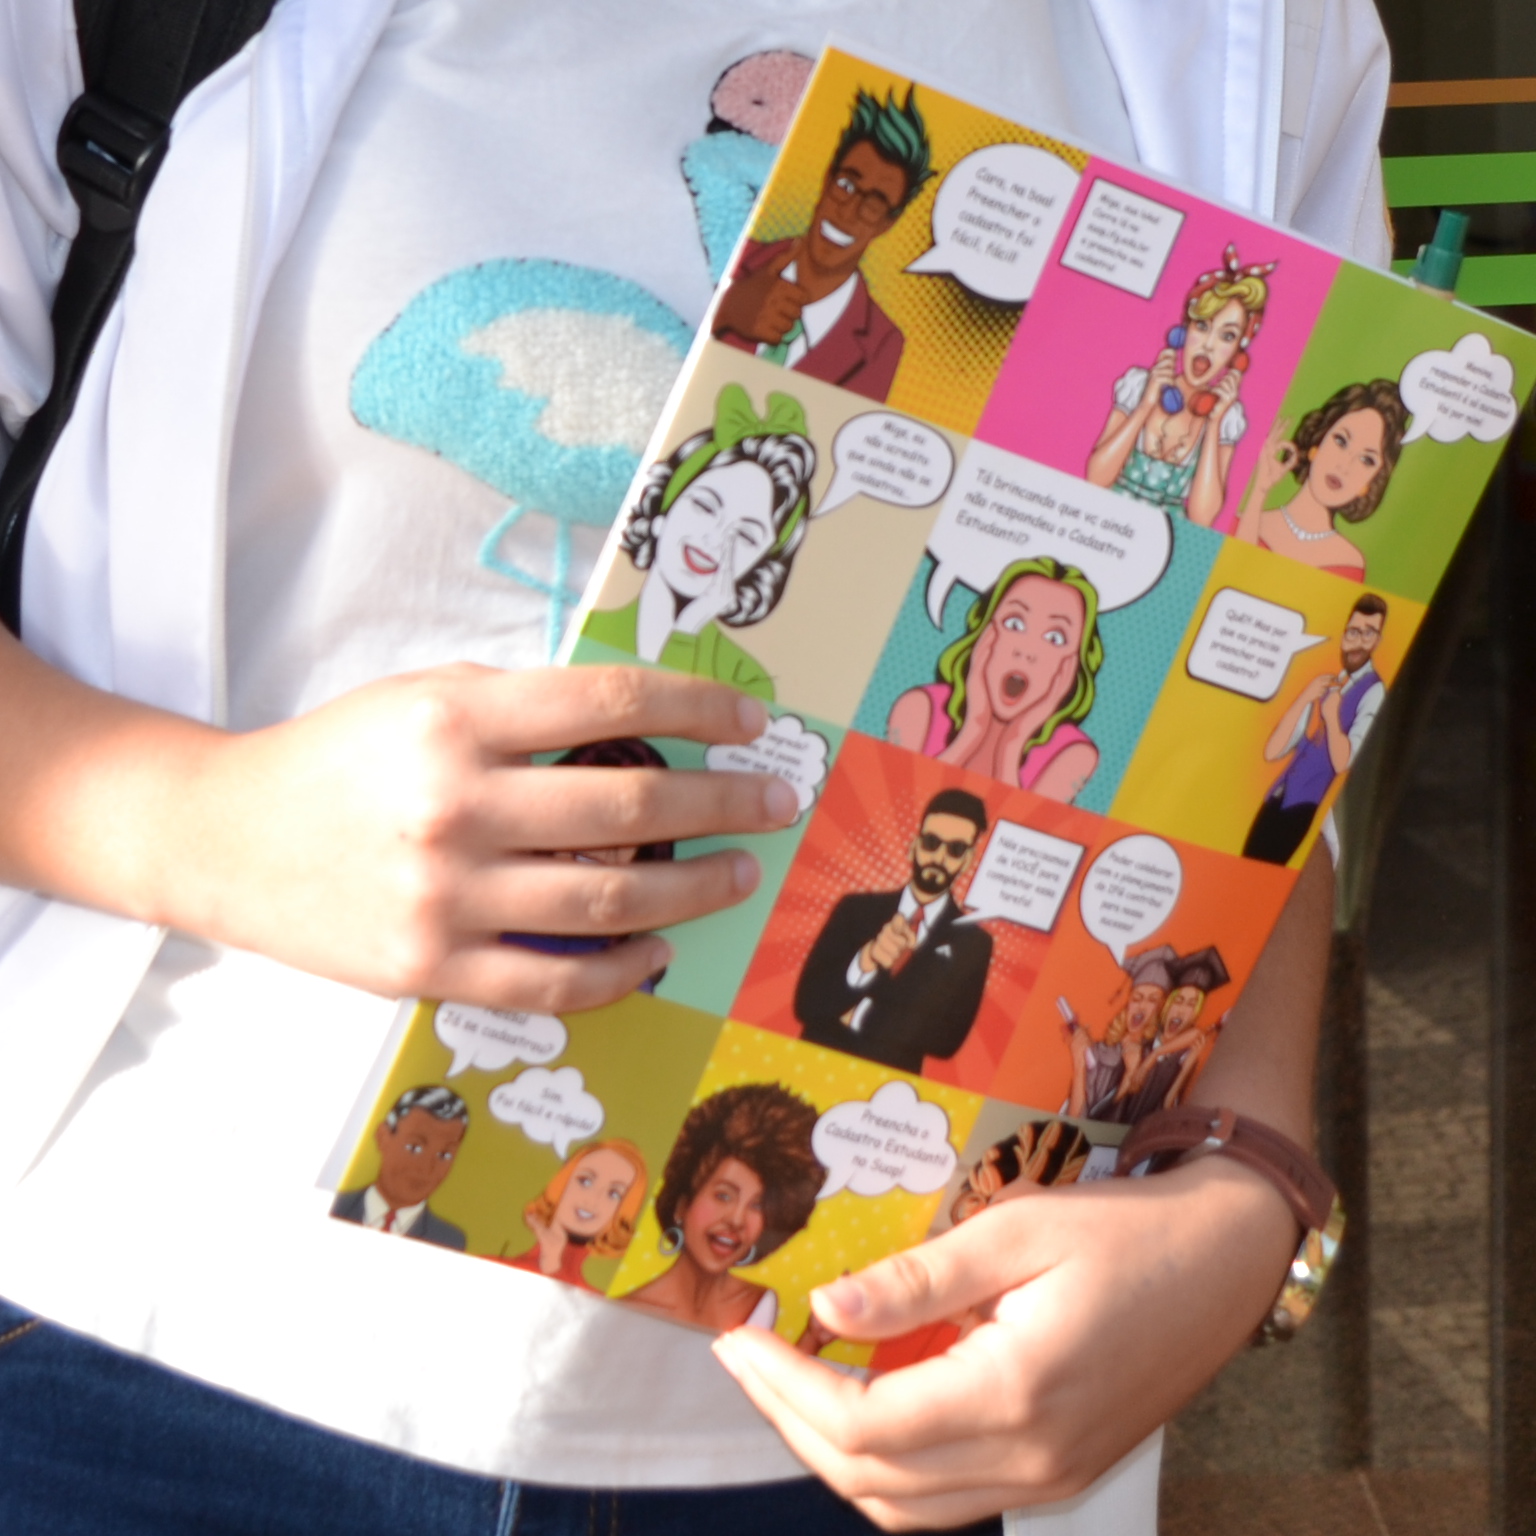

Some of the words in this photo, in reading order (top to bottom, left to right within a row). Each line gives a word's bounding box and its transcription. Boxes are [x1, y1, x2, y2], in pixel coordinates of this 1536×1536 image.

[975, 166, 1006, 191] Cara,
[1010, 183, 1026, 198] na
[1026, 187, 1055, 208] boa!
[966, 185, 1031, 221] Preencher
[1031, 216, 1042, 227] o
[950, 226, 980, 252] fácil,
[958, 210, 1013, 239] cadastro
[1016, 229, 1034, 247] foi
[1419, 377, 1461, 401] Estudantil
[1430, 366, 1471, 387] responder
[864, 434, 882, 449] não
[885, 444, 929, 466] acredito
[847, 450, 865, 464] que
[868, 457, 895, 474] ainda
[899, 467, 916, 481] não
[918, 475, 931, 486] se
[977, 467, 992, 486] Tá
[993, 475, 1056, 509] brincando
[1058, 502, 1081, 520] que
[1084, 512, 1097, 525] vc
[1100, 517, 1135, 540] ainda
[955, 508, 1030, 547] Estudantil?
[965, 490, 987, 508] não
[990, 501, 1054, 536] respondeu
[1057, 526, 1066, 537] o
[1068, 527, 1127, 560] Cadastro
[1219, 626, 1235, 638] que
[1248, 636, 1281, 654] preciso
[1254, 619, 1272, 633] Mas
[1271, 627, 1288, 637] por
[1210, 641, 1255, 661] preencher
[1215, 659, 1260, 680] cadastro?
[999, 836, 1017, 851] Nós
[1018, 845, 1070, 868] precisamos
[986, 869, 1033, 890] completar
[996, 854, 1007, 865] de
[1011, 857, 1039, 876] VOCÊ
[1039, 869, 1060, 883] para
[1094, 865, 1111, 876] com
[1120, 874, 1174, 895] planejamento
[1134, 862, 1173, 879] colaborar
[443, 1010, 460, 1025] Já
[463, 1019, 478, 1033] se
[481, 1026, 554, 1055] cadastrou?
[497, 1091, 514, 1107] Foi
[517, 1097, 543, 1116] fácil
[555, 1112, 595, 1132] rápido!
[861, 1108, 919, 1138] Preencha
[921, 1129, 929, 1140] o
[824, 1121, 882, 1149] Cadastro
[884, 1137, 949, 1168] Estudantil
[852, 1154, 867, 1168] no
